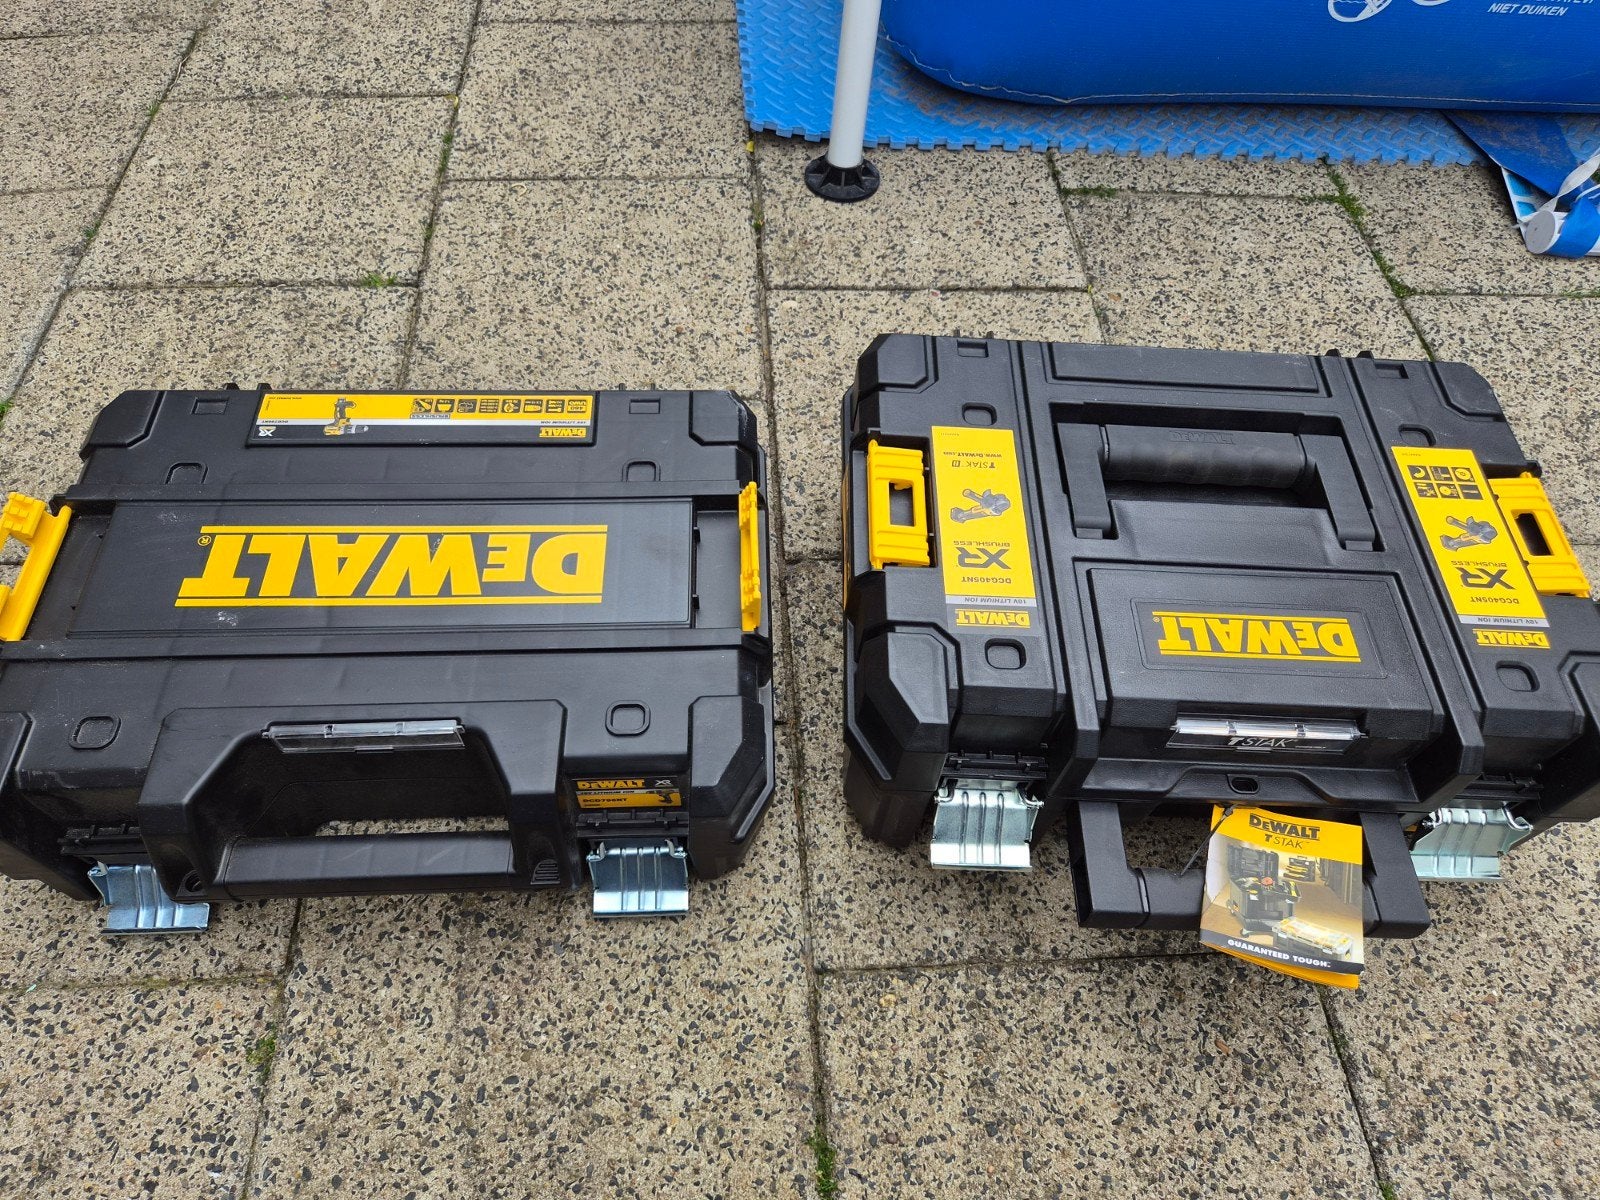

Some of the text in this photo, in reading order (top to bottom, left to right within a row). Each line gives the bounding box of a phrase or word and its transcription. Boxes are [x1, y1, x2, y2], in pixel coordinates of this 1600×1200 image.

[1487, 3, 1568, 16] NIET DUIKEN
[176, 531, 608, 600] DEWALT
[955, 546, 1012, 570] XR
[1451, 560, 1507, 568] BRUSHLESS
[961, 576, 1012, 584] DCG405NT
[1454, 566, 1517, 590] XR
[1470, 596, 1520, 605] DCG405NT
[957, 610, 1030, 627] DEWALT
[1156, 615, 1360, 659] DEWALT
[1475, 629, 1550, 648] DEWALT
[577, 779, 673, 790] DEWALT XR
[1249, 813, 1321, 841] DEWALT
[1227, 939, 1290, 961] GUARANTEED
